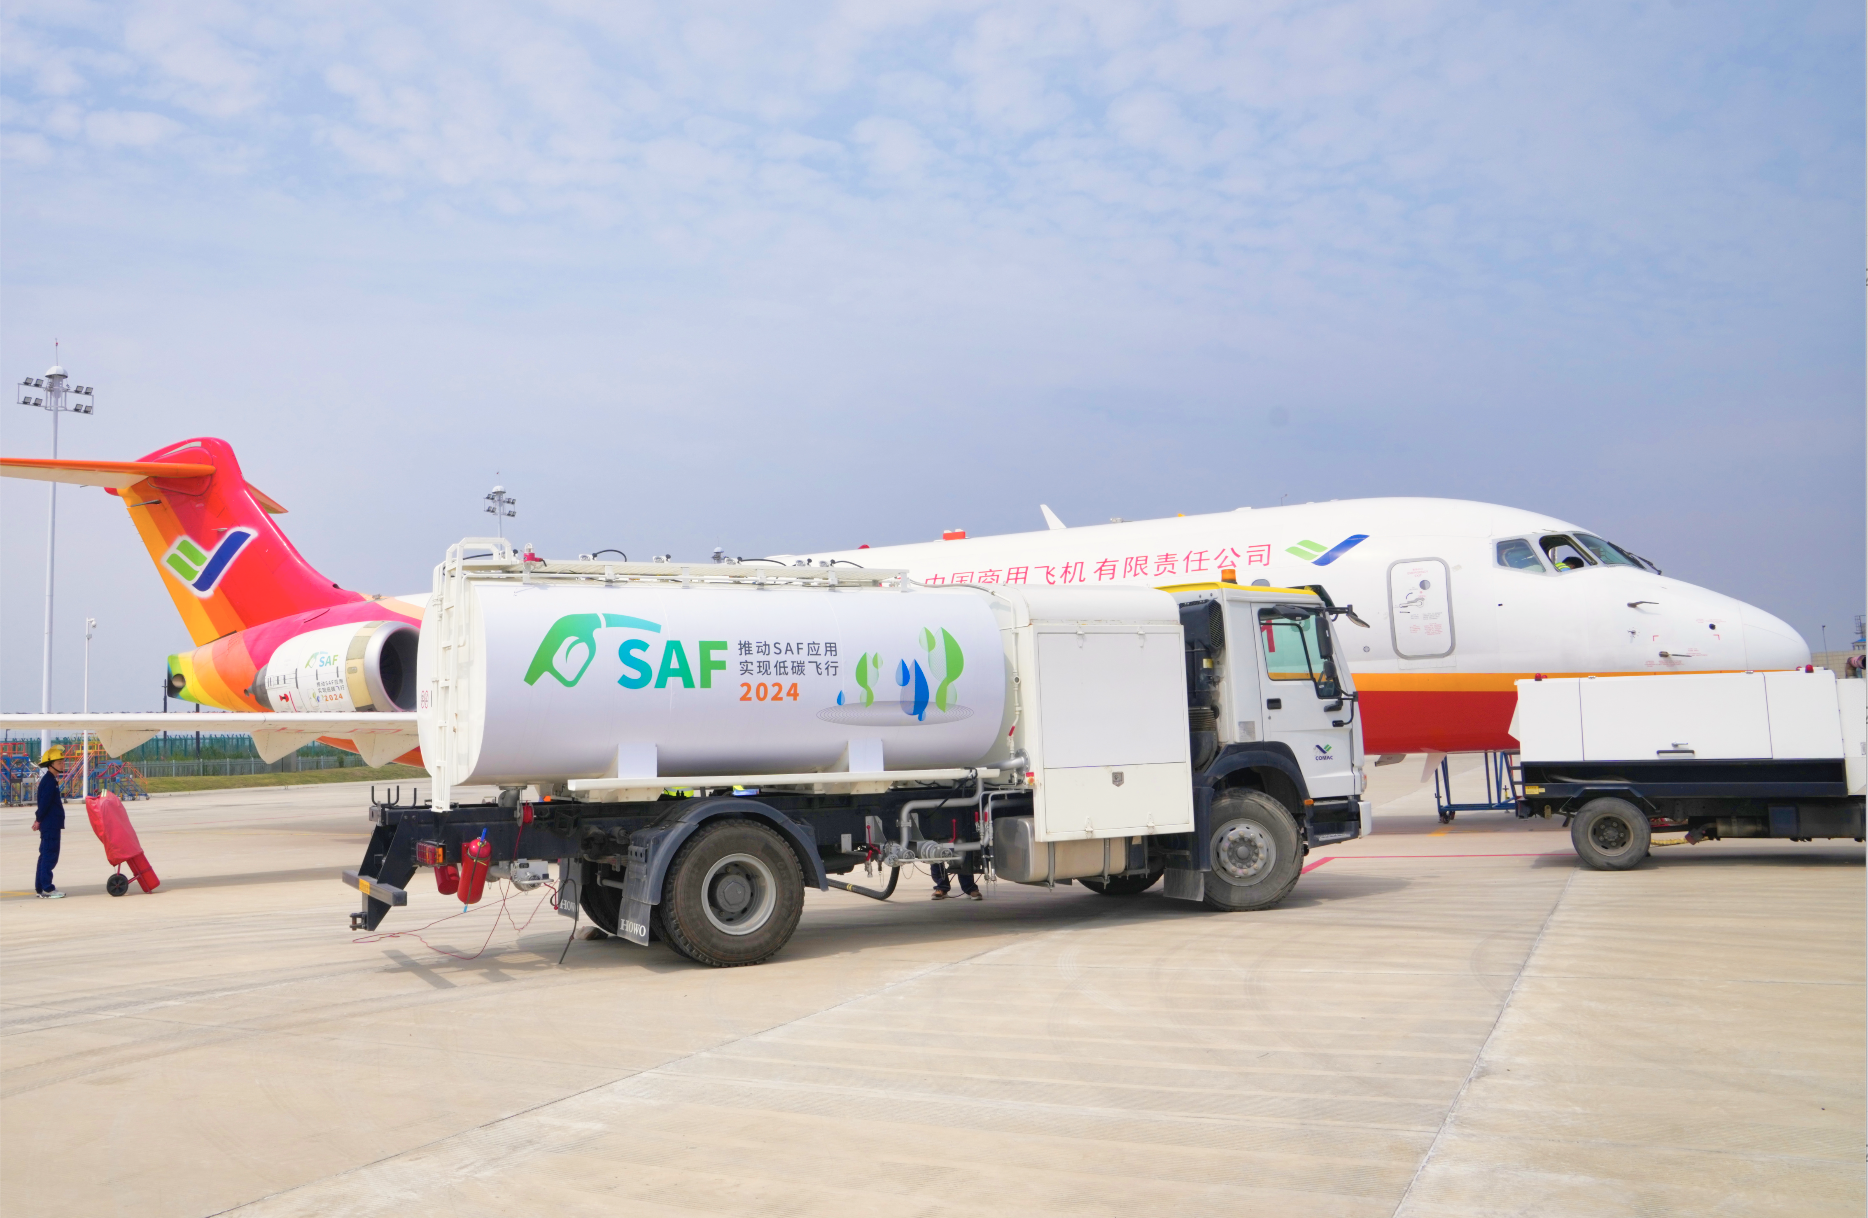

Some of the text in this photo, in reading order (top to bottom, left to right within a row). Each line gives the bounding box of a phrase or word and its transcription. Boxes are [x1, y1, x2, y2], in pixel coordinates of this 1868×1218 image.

[738, 640, 838, 657] 推动SAF应用
[318, 654, 339, 668] SAF
[617, 638, 728, 690] SAF
[739, 660, 839, 677] 实现低碳飞行
[324, 693, 344, 702] 2024
[739, 682, 800, 702] 2024
[560, 899, 578, 913] HOW
[620, 918, 647, 937] HOWO
